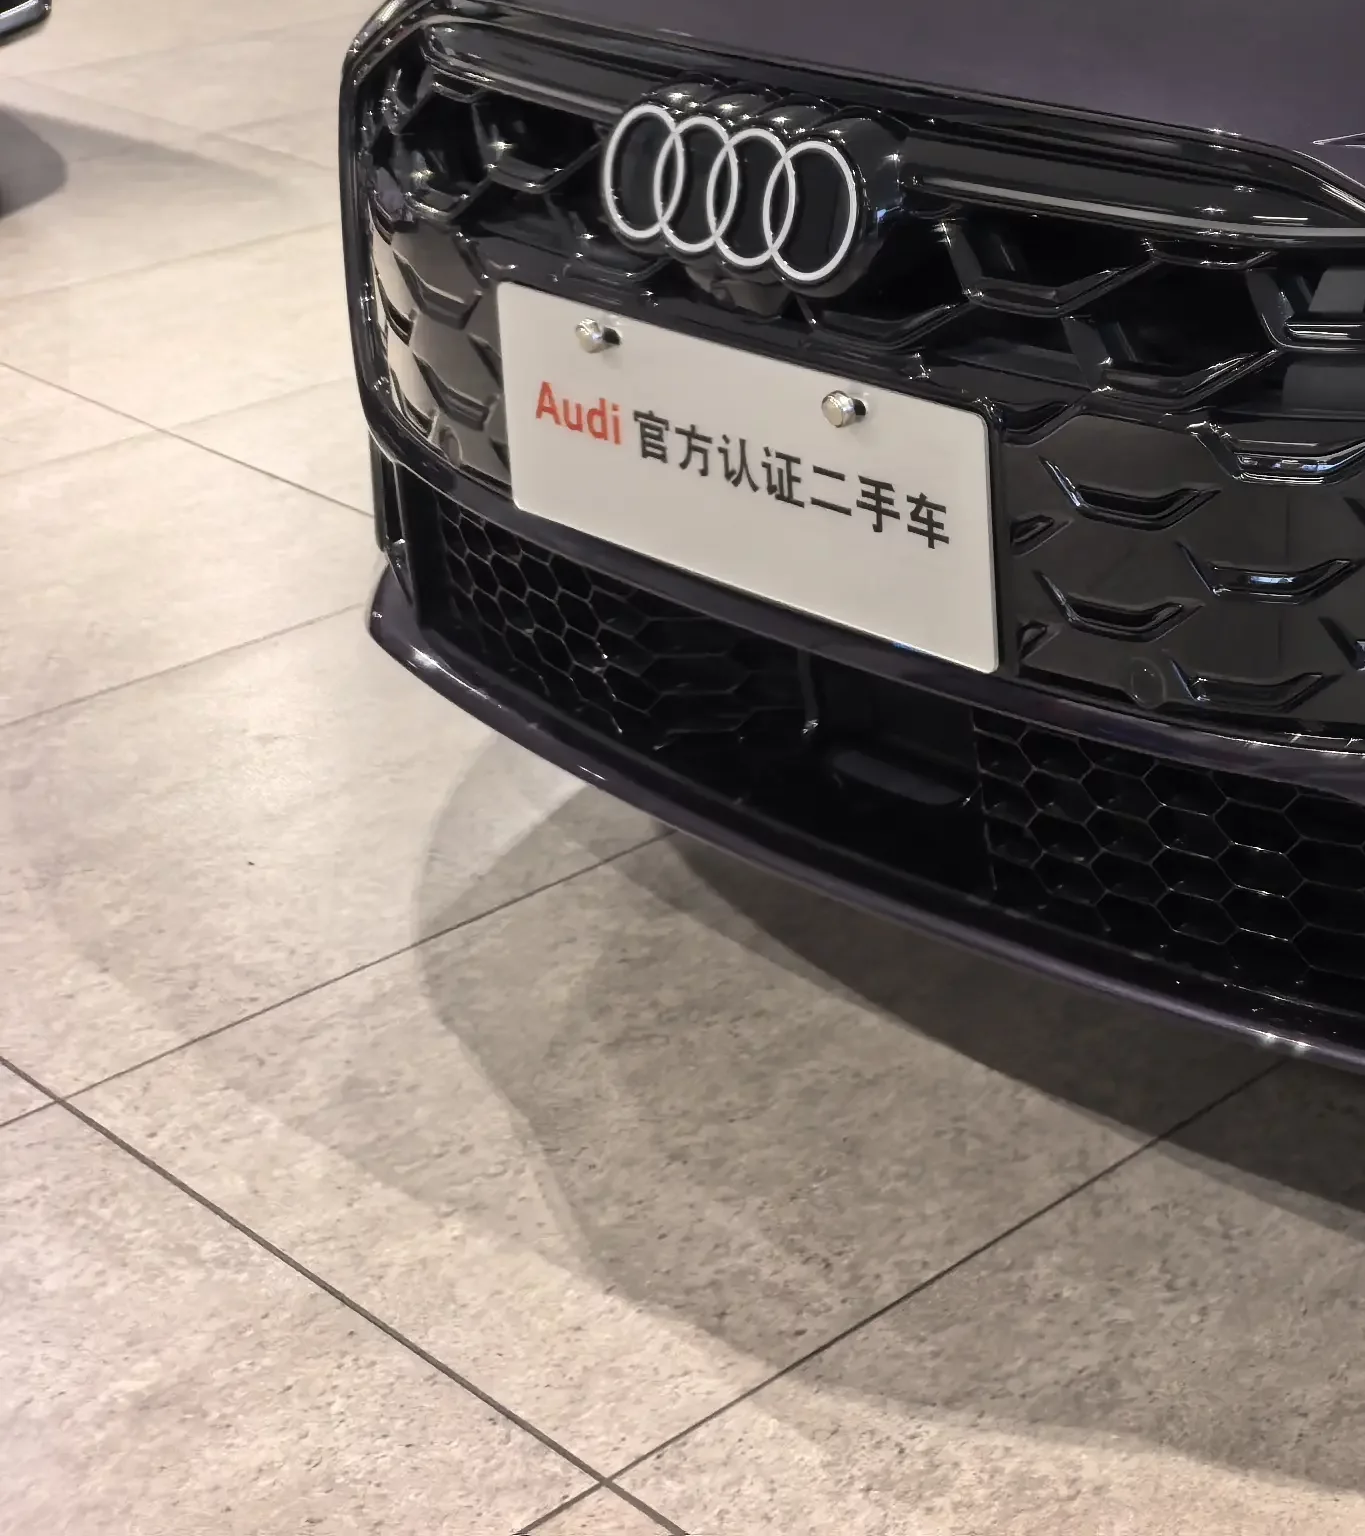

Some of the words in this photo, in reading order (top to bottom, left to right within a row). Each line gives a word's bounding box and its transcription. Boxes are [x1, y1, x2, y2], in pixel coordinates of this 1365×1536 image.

[535, 381, 622, 445] Audi
[633, 409, 950, 550] 官方认证二手车
